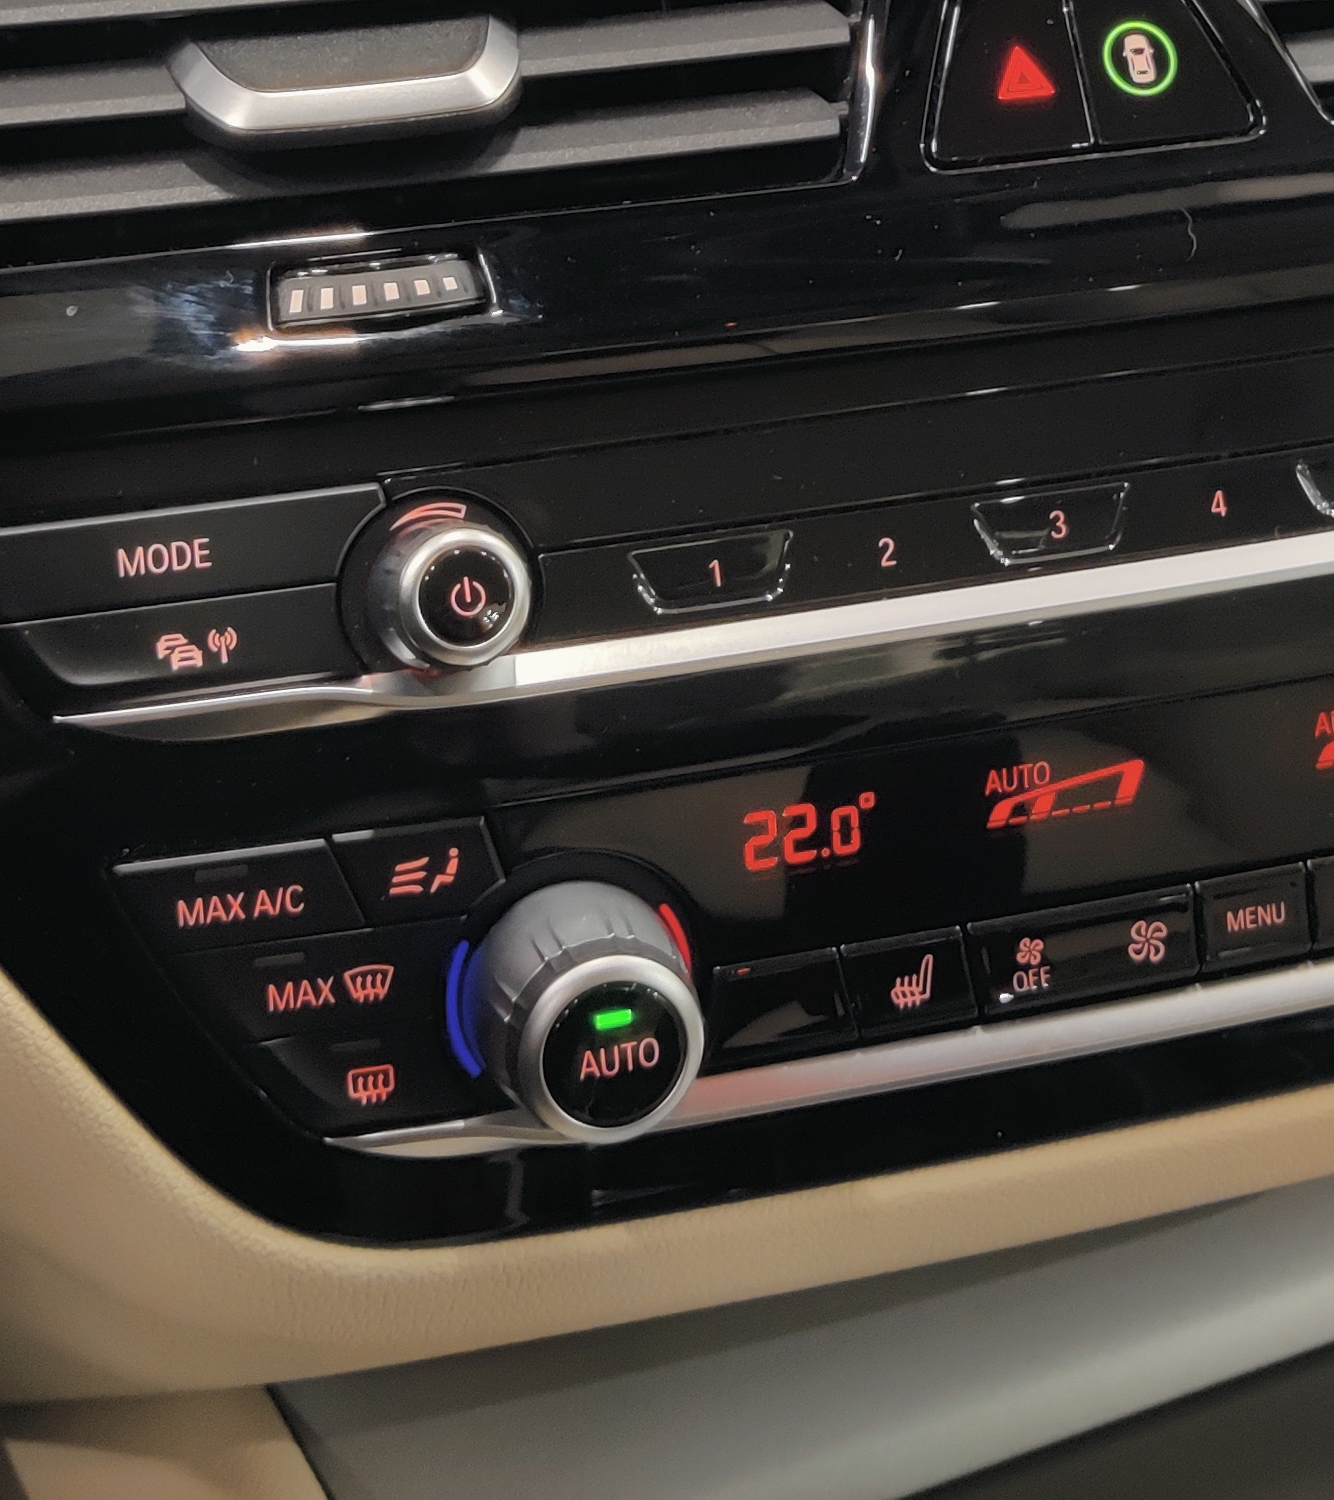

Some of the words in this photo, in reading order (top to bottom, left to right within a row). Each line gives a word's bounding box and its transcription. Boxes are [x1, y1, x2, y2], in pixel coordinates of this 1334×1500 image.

[1211, 490, 1228, 517] 4
[1049, 510, 1068, 540] 3
[116, 538, 213, 577] MODE
[879, 537, 897, 568] 2
[708, 560, 722, 587] 1
[985, 761, 1052, 796] AUTO
[177, 894, 245, 928] MAX
[252, 884, 305, 919] A/C
[1226, 901, 1286, 932] MENU
[1012, 964, 1051, 992] OFF
[267, 978, 335, 1012] MAX
[579, 1037, 661, 1080] AUTO
